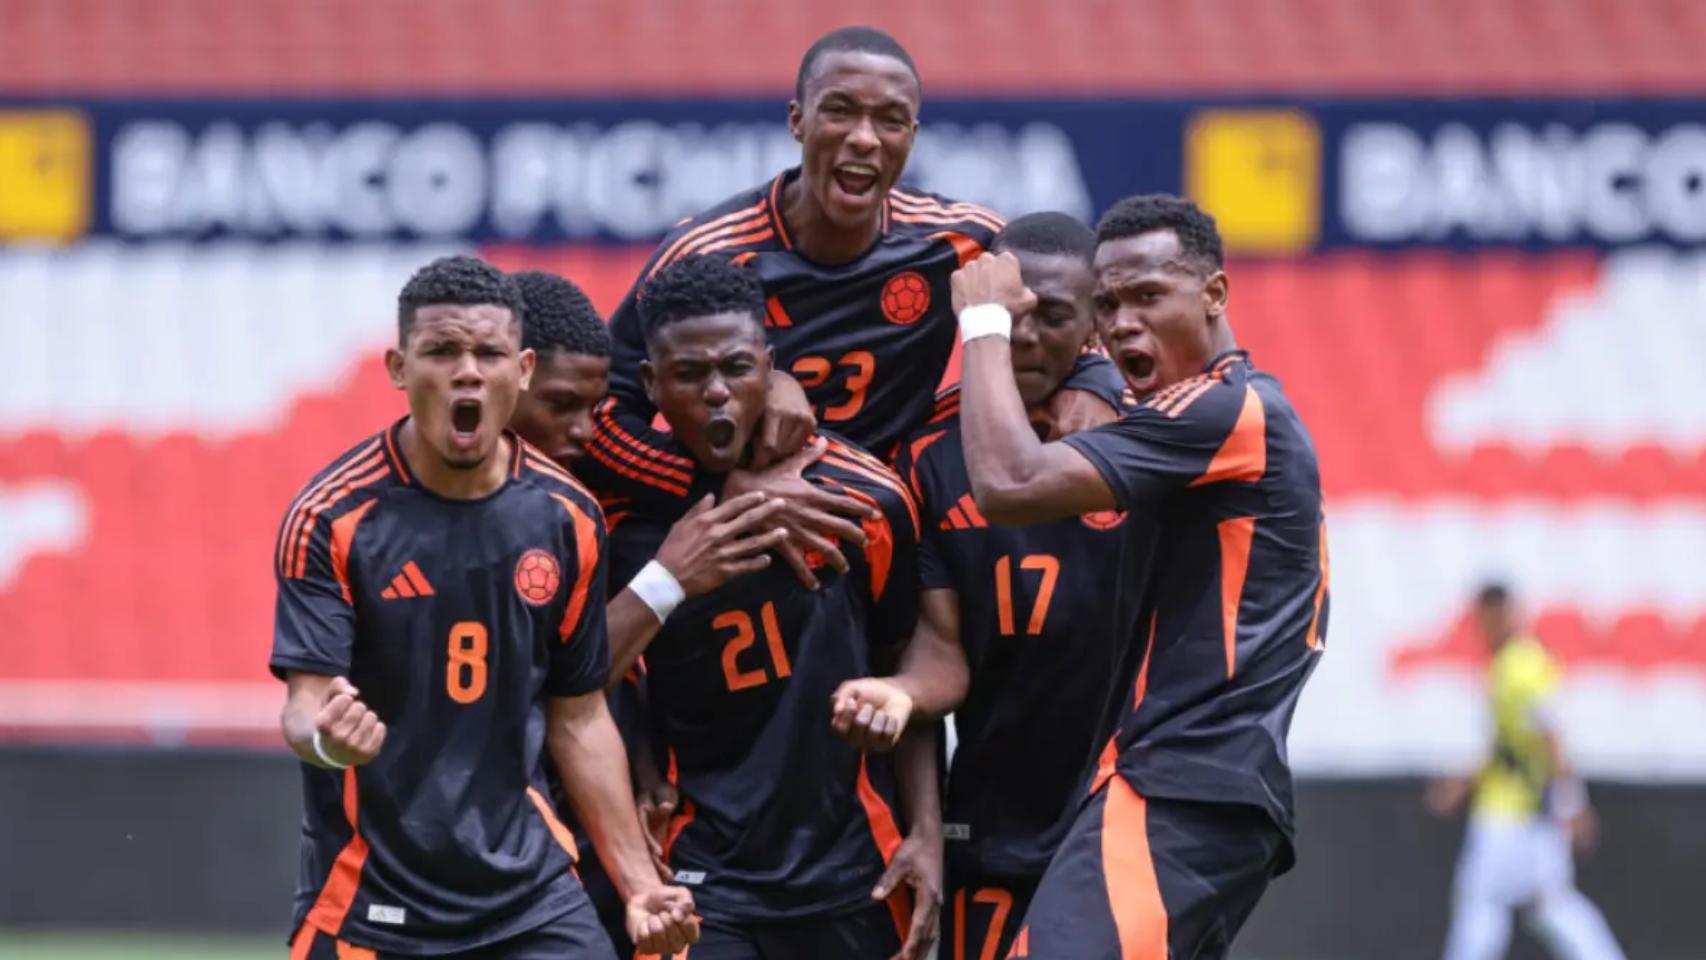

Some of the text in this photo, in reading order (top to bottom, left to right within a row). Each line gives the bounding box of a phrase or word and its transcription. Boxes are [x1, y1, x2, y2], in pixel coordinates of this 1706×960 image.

[111, 121, 486, 236] BANCO
[995, 554, 1060, 635] 17
[447, 621, 487, 704] 8
[712, 601, 791, 692] 21
[953, 887, 1012, 960] 17
